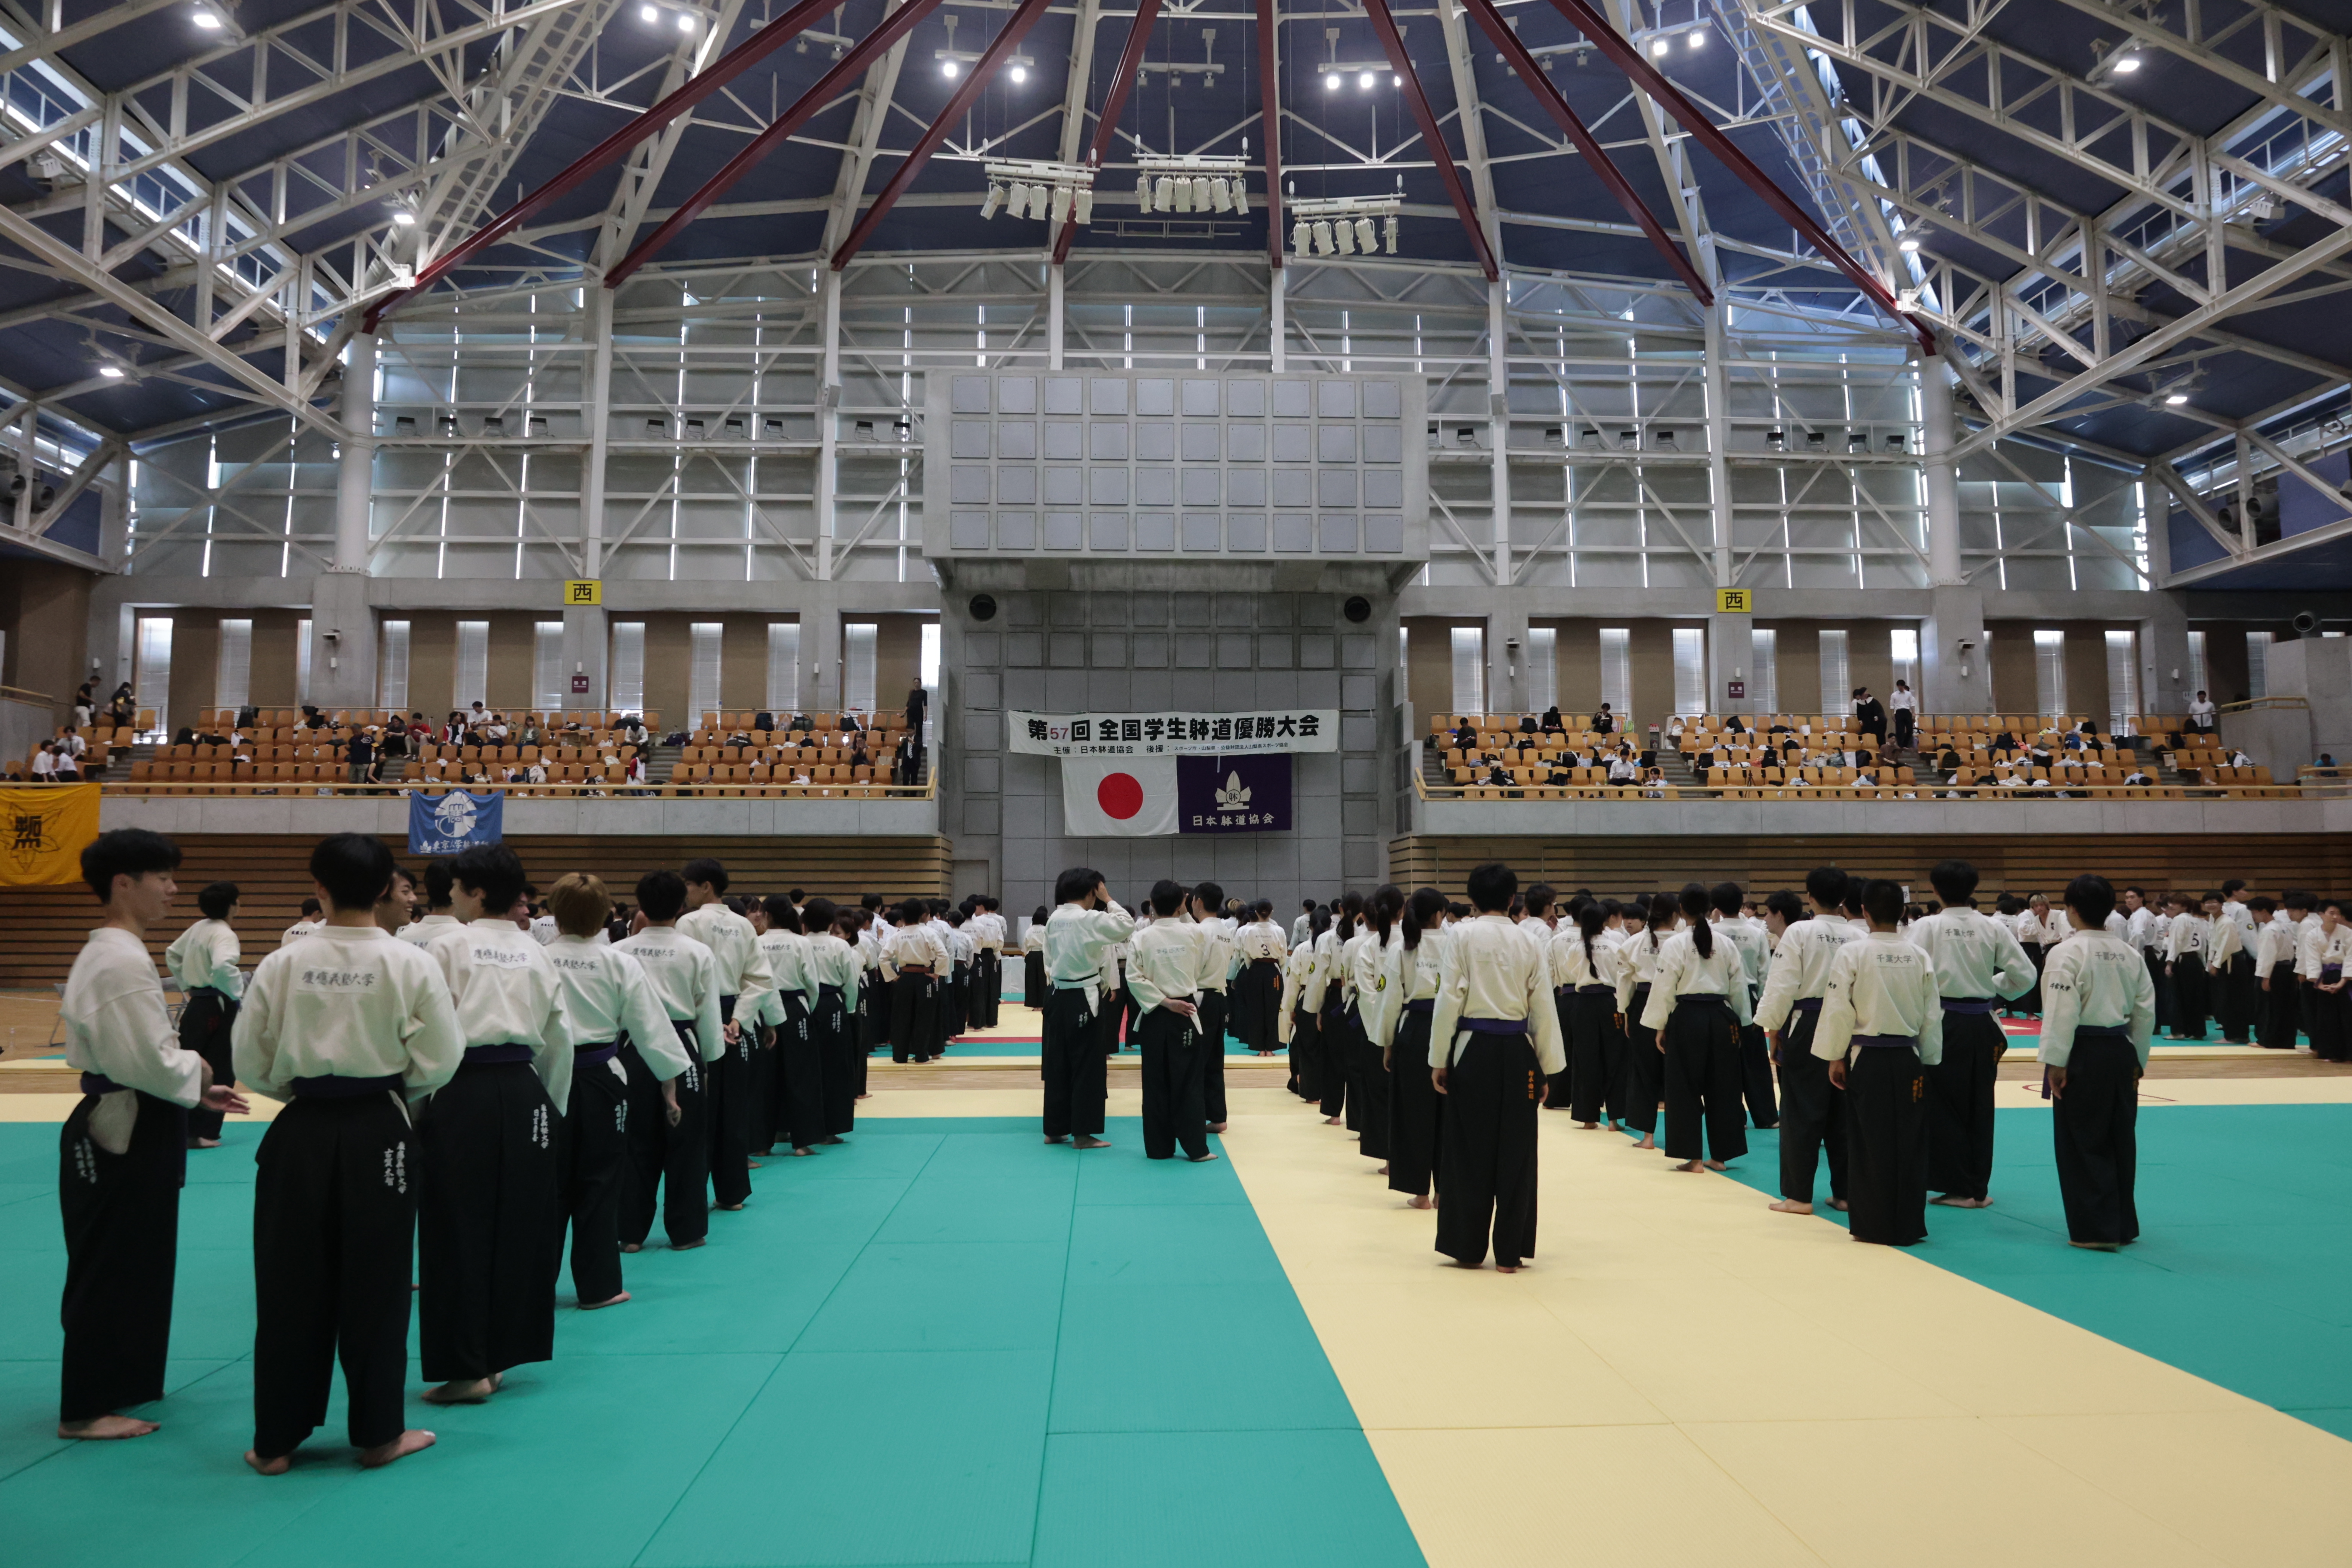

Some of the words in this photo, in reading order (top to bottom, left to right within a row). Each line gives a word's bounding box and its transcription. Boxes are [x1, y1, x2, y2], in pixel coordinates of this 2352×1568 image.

[573, 584, 593, 602] 西
[1725, 592, 1743, 609] 西
[1028, 719, 1090, 742] 第57回
[1099, 715, 1319, 741] 全国学生躰道優勝大会
[1193, 813, 1274, 827] 日本躰道協会
[1945, 928, 1975, 937] 千葉大学
[2191, 933, 2199, 947] 5
[1261, 944, 1271, 956] 3
[1877, 954, 1912, 963] 千葉大学
